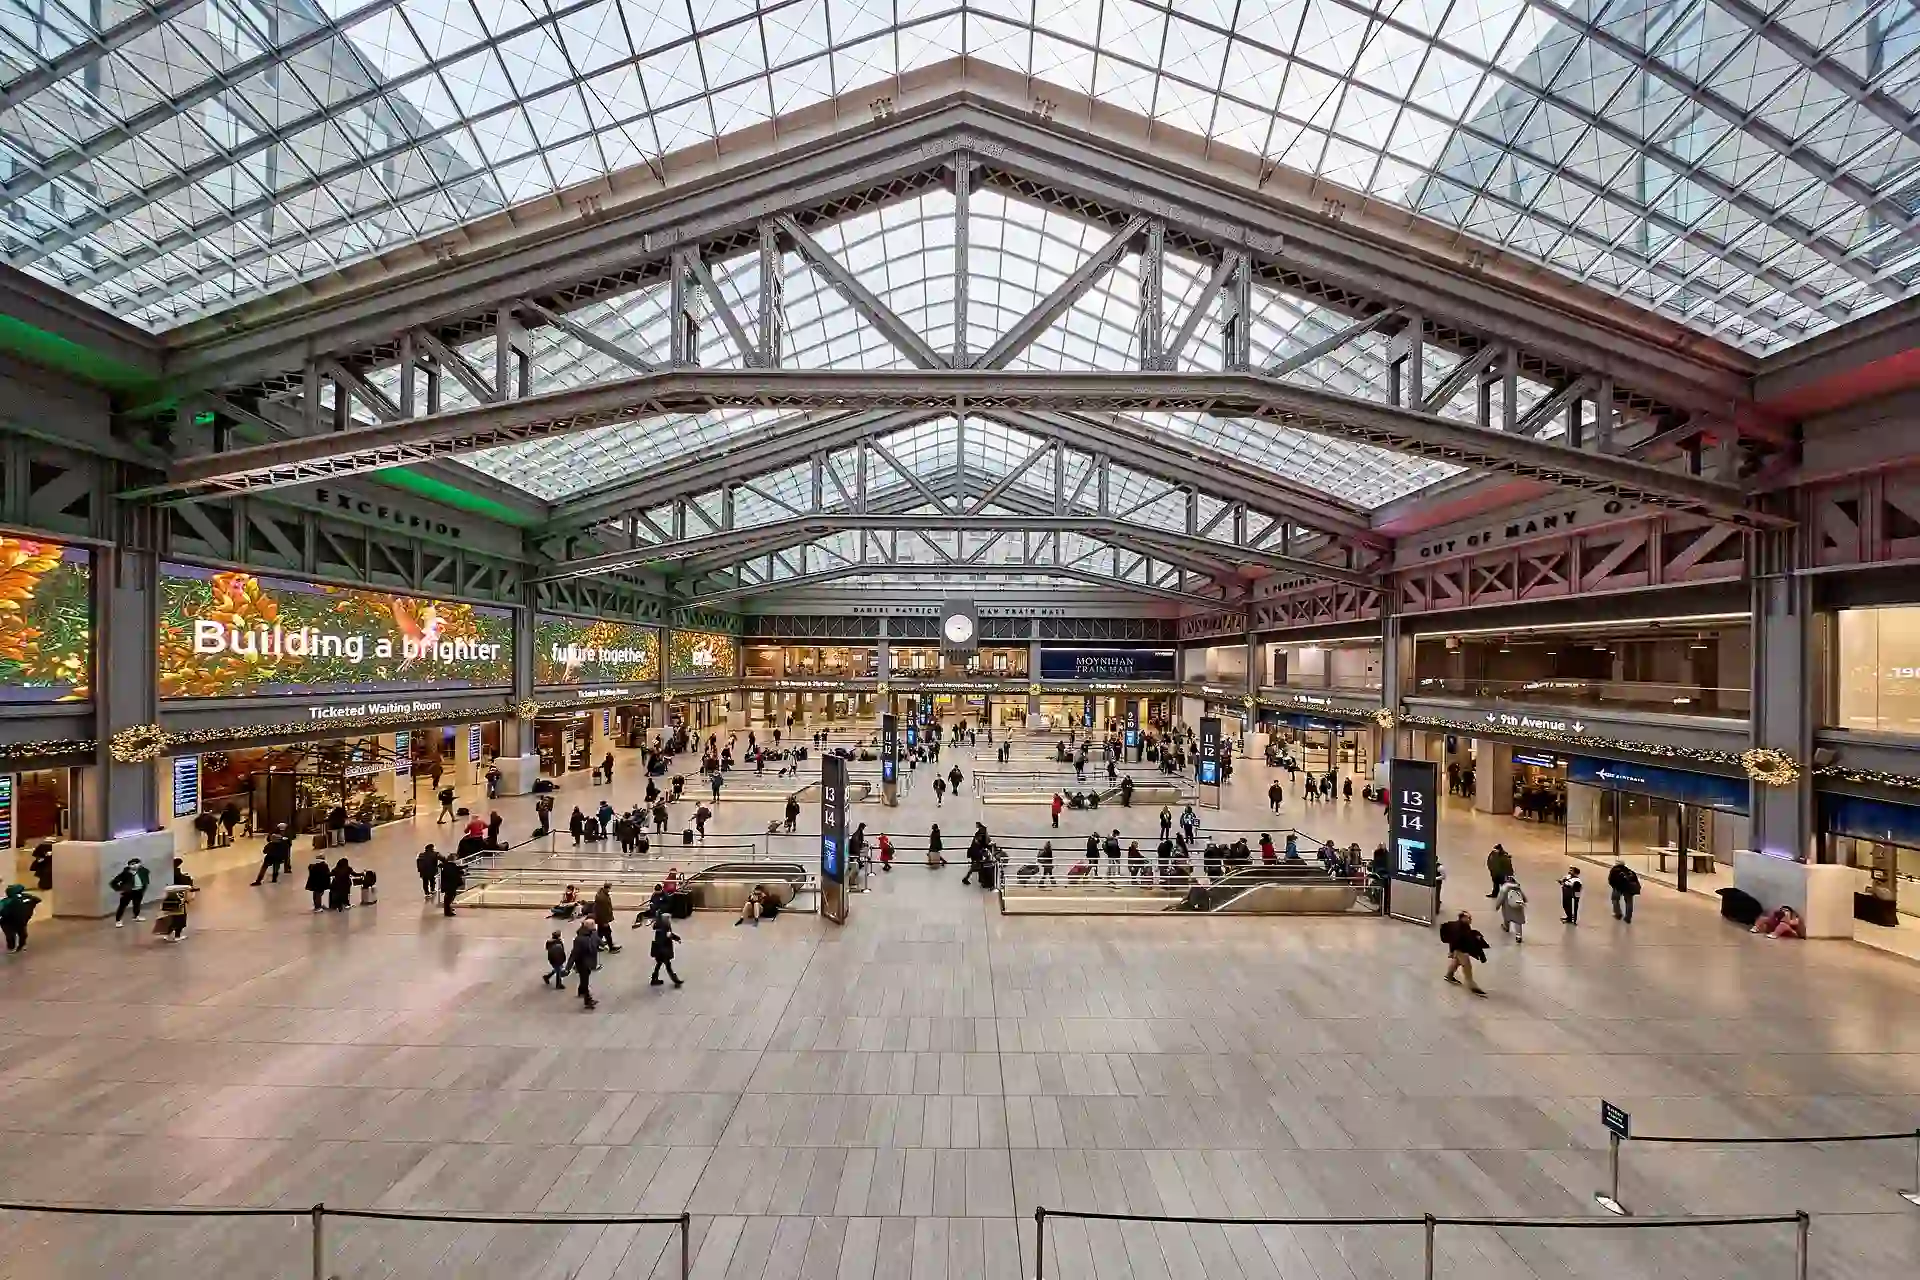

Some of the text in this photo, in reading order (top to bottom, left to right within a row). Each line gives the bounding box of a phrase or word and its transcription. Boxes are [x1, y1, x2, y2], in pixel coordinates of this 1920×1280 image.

[316, 488, 460, 538] EXCELSIOR
[1420, 541, 1456, 558] OUT
[1467, 531, 1492, 547] OF
[1505, 510, 1577, 538] MANY
[194, 619, 500, 665] Building a brighter
[552, 642, 595, 664] future
[1076, 657, 1134, 665] MOYNIHAN
[1076, 665, 1134, 674] TRAIN HALL
[309, 701, 441, 719] Ticketed Waiting Room
[1500, 714, 1566, 731] 9th Avenue
[885, 731, 891, 741] 11
[1205, 734, 1213, 742] 11
[884, 745, 892, 754] 12
[1204, 747, 1214, 756] 12
[824, 786, 835, 801] 13
[1402, 790, 1423, 806] 13
[824, 810, 835, 827] 14
[1401, 814, 1423, 831] 14
